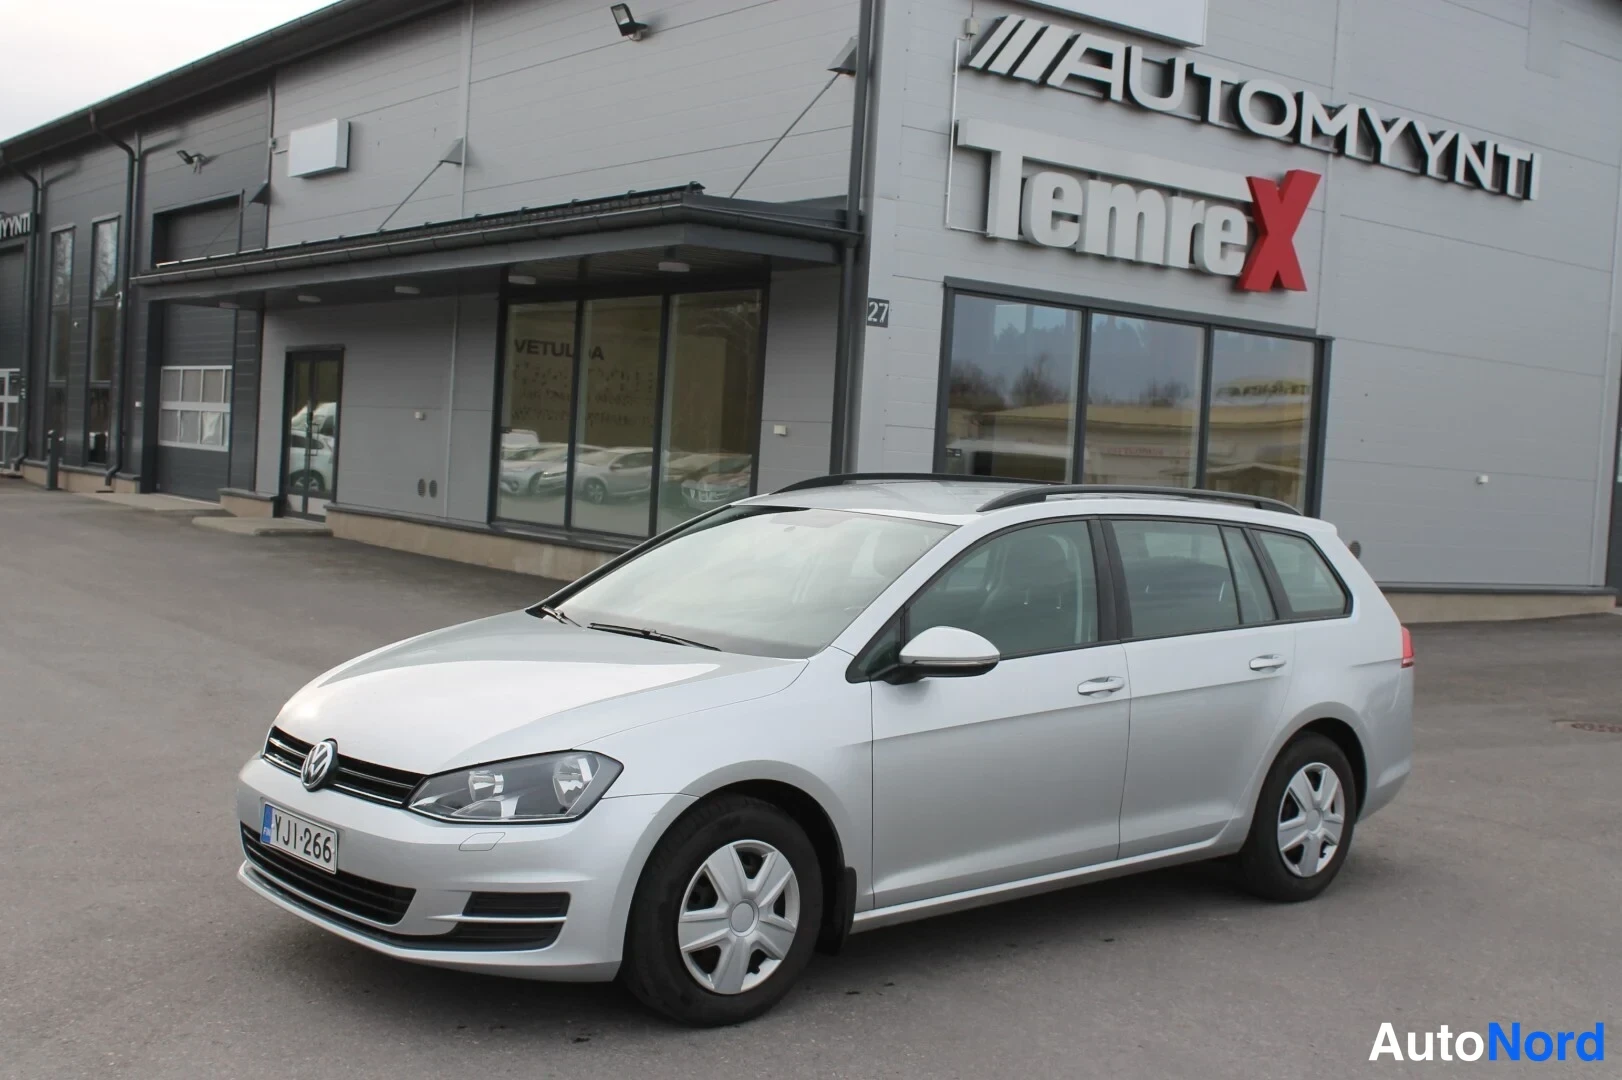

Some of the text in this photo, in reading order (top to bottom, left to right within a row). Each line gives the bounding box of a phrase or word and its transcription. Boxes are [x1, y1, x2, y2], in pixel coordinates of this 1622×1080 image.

[1046, 31, 1541, 200] AUTOMYYNTI
[0, 212, 30, 239] YYNTI
[868, 301, 889, 323] 27
[514, 338, 605, 361] VETULA
[275, 814, 332, 863] YJI-266
